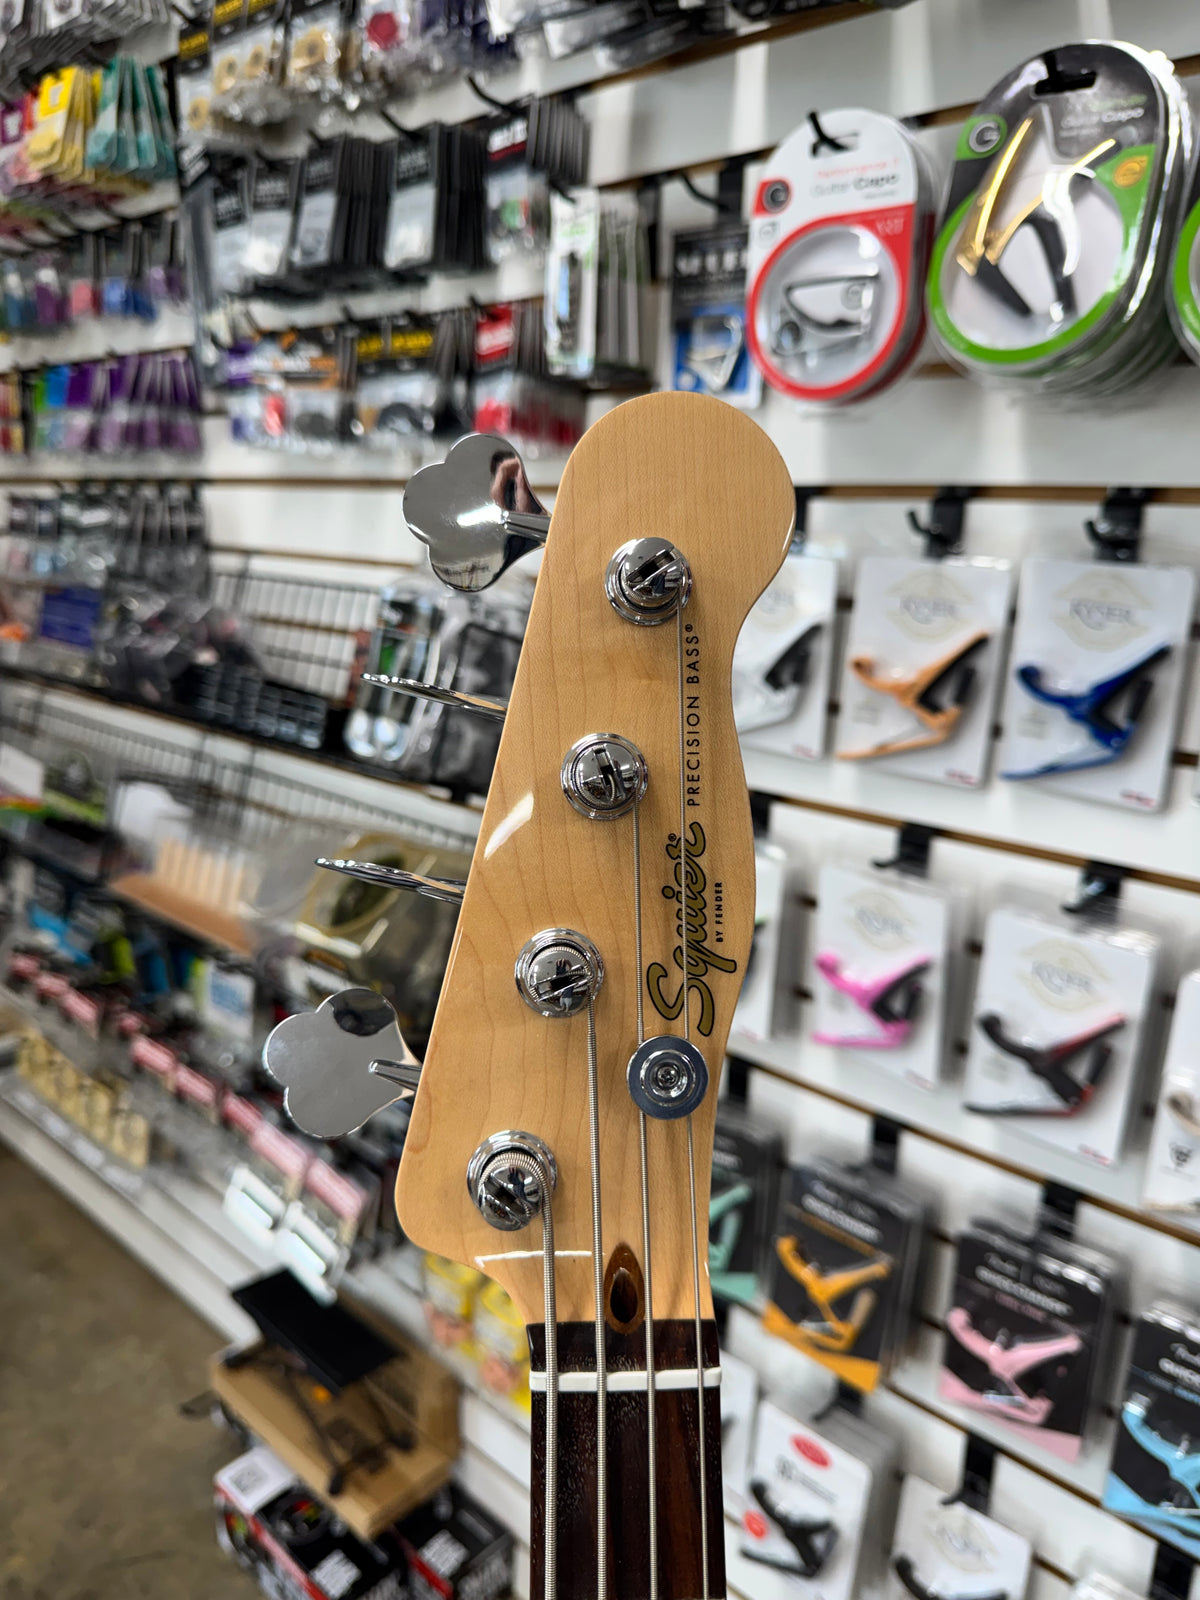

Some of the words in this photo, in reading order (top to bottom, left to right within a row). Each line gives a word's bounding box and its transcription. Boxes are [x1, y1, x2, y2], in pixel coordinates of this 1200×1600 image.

[686, 696, 701, 807] PRECISION
[714, 881, 724, 926] FENDER
[715, 930, 724, 943] BY
